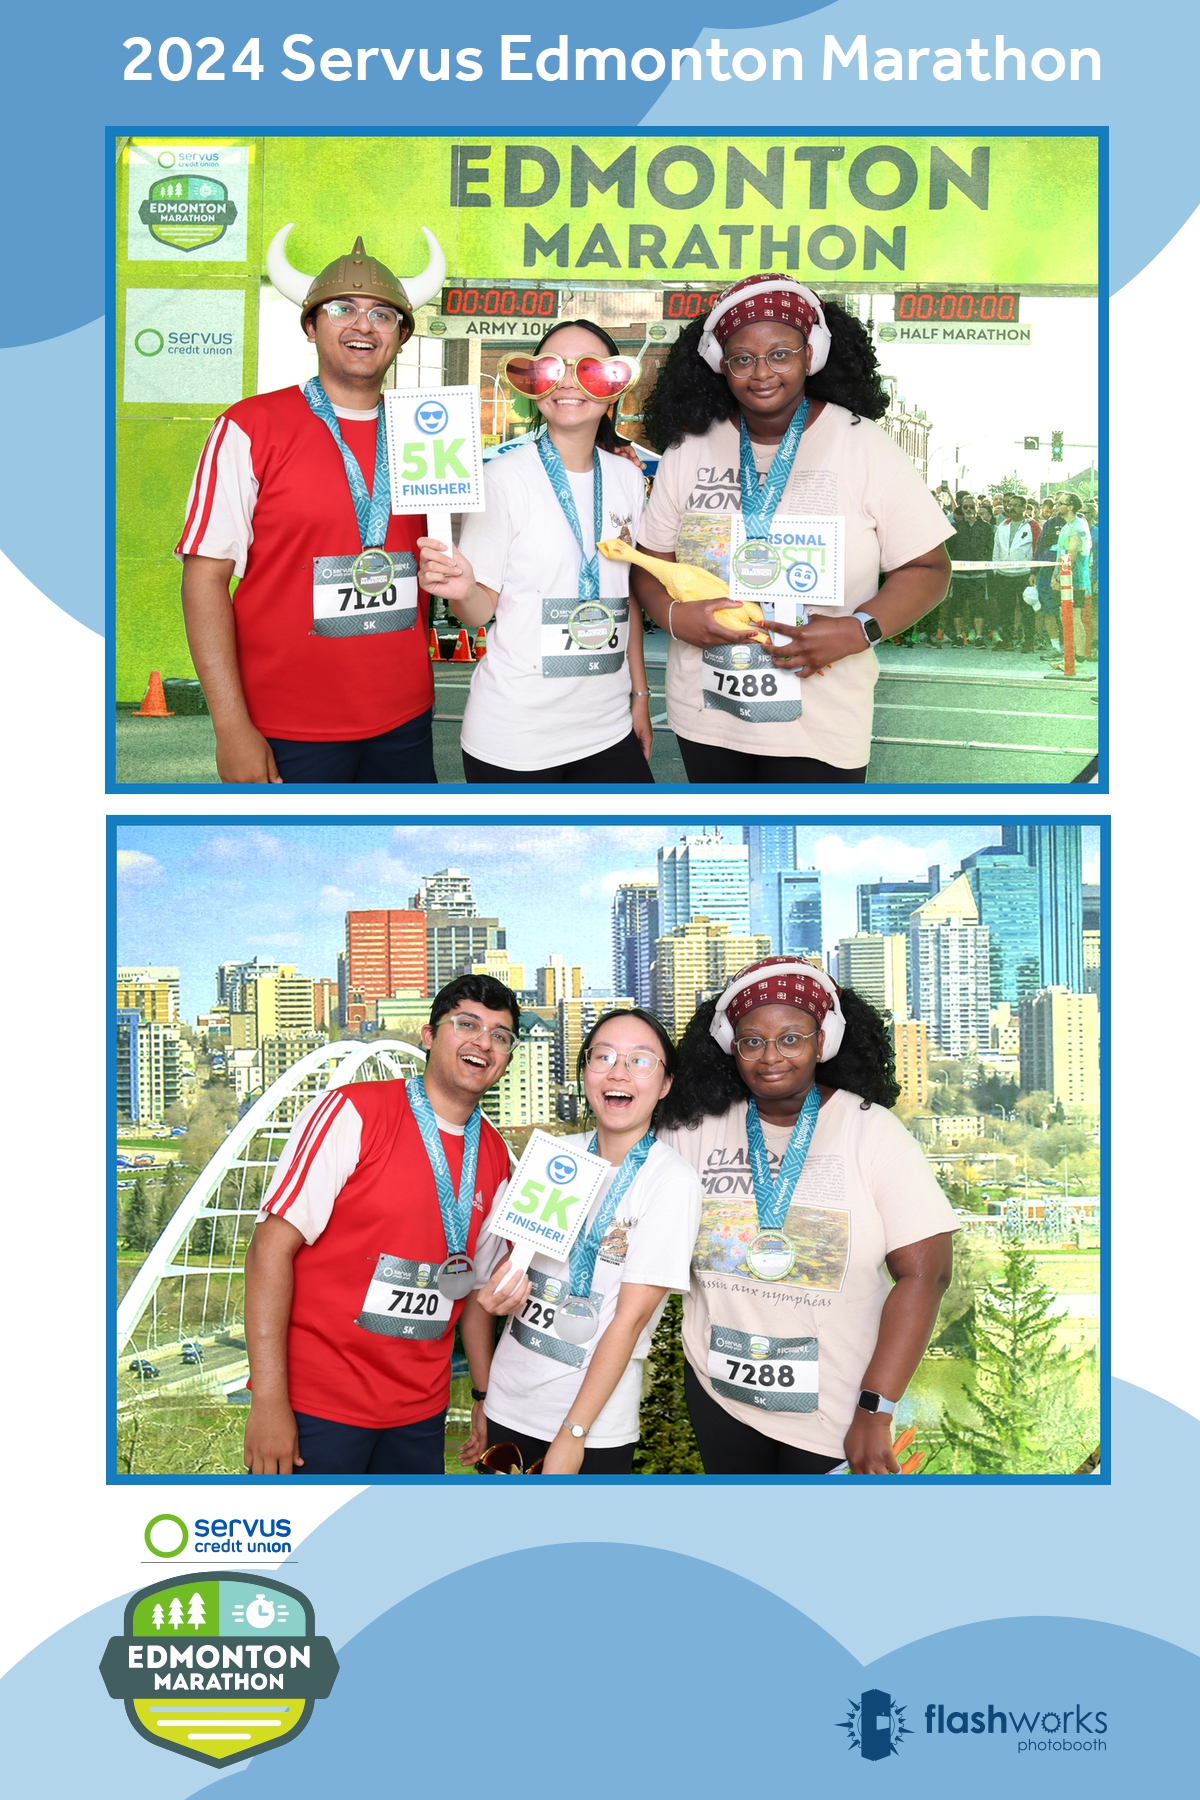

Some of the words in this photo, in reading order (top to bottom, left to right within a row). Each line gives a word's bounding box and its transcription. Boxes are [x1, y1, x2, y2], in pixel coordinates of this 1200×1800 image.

[178, 152, 219, 161] servus
[450, 145, 991, 211] EDMONTON
[149, 202, 227, 214] EDMONTON
[160, 214, 215, 222] MARATHON
[523, 222, 906, 272] MARATHON
[465, 321, 517, 335] ARMY
[900, 328, 939, 340] HALF
[943, 328, 1031, 341] MARATHON
[168, 331, 233, 345] servus
[168, 345, 200, 355] credit
[202, 347, 233, 355] union
[401, 438, 472, 481] 5K
[402, 482, 472, 497] FINISHER!
[685, 491, 741, 511] MON
[767, 533, 827, 547] RSONAL
[363, 620, 376, 630] 5K
[561, 627, 619, 650] 76
[588, 661, 600, 671] 5K
[712, 670, 778, 698] 7288
[739, 707, 752, 718] 5K
[701, 1175, 756, 1195] MON
[511, 1178, 581, 1232] 5K
[505, 1211, 566, 1244] FINISHER!
[387, 1289, 439, 1316] 7120
[731, 1283, 759, 1297] aux
[762, 1290, 832, 1309] nymphéas
[402, 1325, 415, 1335] 5K
[529, 1337, 542, 1348] 5K
[726, 1359, 795, 1388] 7288
[754, 1396, 767, 1406] 5K
